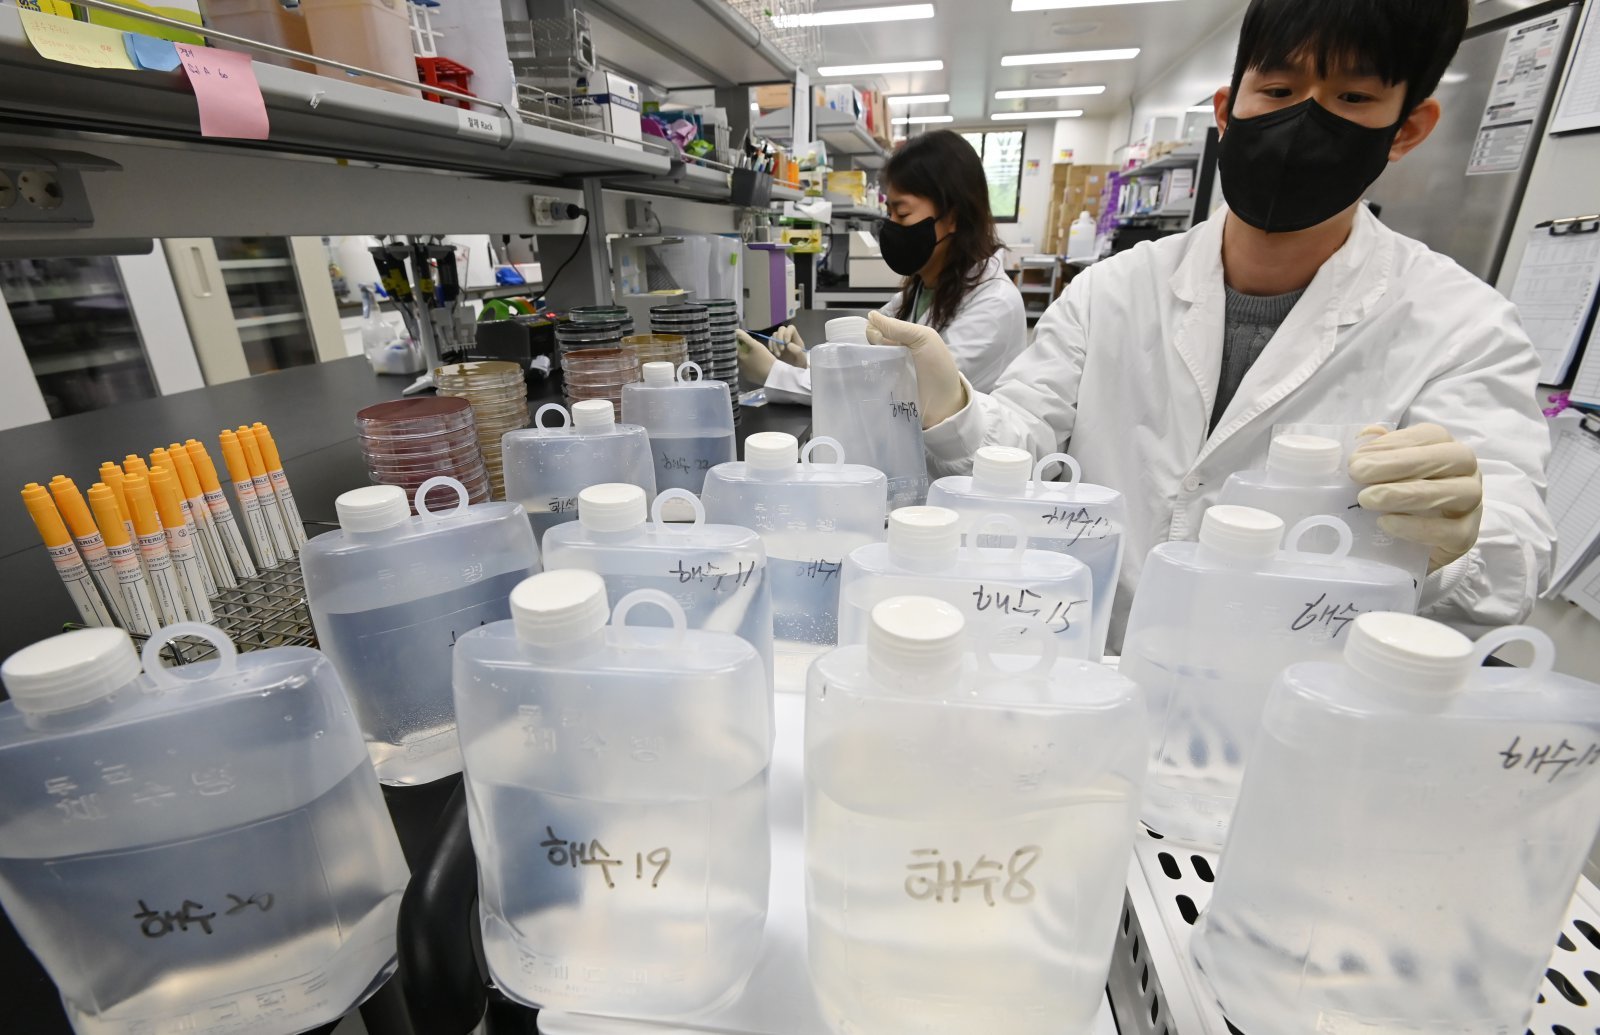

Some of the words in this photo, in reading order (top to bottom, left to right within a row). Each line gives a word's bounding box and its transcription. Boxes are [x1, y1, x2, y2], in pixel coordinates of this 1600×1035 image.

[1045, 600, 1088, 634] 15
[540, 825, 624, 889] 해수
[636, 847, 671, 888] 19
[134, 899, 216, 938] 해수
